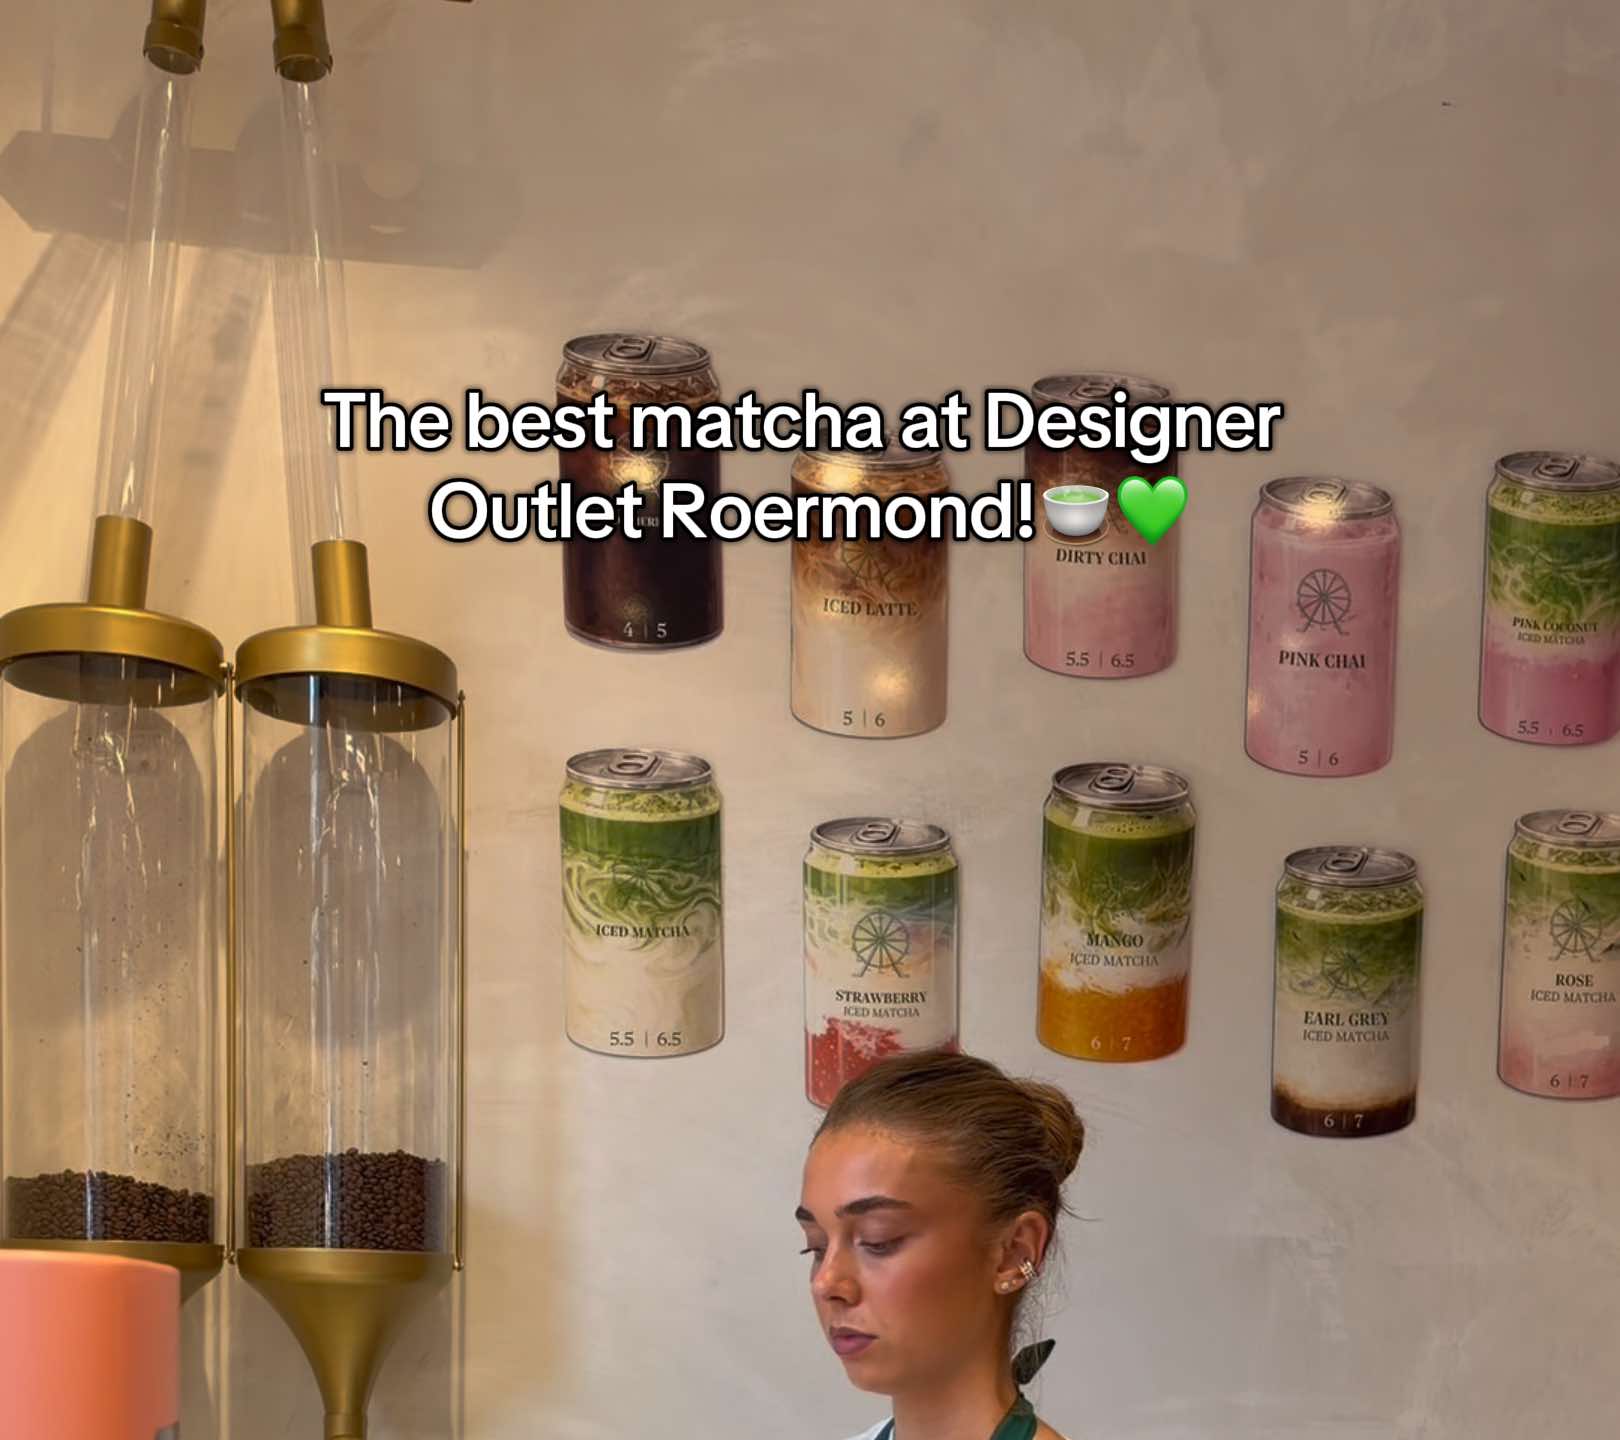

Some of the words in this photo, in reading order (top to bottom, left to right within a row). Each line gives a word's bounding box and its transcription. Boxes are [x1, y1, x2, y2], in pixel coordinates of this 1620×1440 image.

[1055, 547, 1104, 565] DIRTY
[1107, 550, 1147, 566] CHAI
[823, 597, 861, 616] ICED
[865, 599, 918, 618] LATTE
[623, 622, 633, 638] 4
[657, 622, 667, 638] 5
[1512, 616, 1541, 631] PINK
[1543, 619, 1599, 634] COCONUT
[1517, 631, 1541, 644] ICED
[1066, 651, 1089, 667] 5.5
[1111, 652, 1134, 668] 6.5
[1278, 649, 1320, 668] PINK
[1324, 652, 1366, 669] CHAI
[842, 710, 852, 727] 5
[874, 711, 885, 728] 6
[1517, 720, 1539, 735] 5.5
[1562, 722, 1584, 737] 6.5
[1298, 749, 1308, 764] 5
[1329, 751, 1339, 766] 6
[596, 924, 629, 938] ICED
[632, 925, 691, 939] MATCHA
[1087, 932, 1144, 948] MANGO
[1070, 952, 1100, 966] ICED
[1103, 954, 1159, 967] MATCHA
[1555, 973, 1594, 987] ROSE
[835, 989, 927, 1005] STRAWBERRY
[1530, 989, 1560, 1003] ICED
[1563, 991, 1617, 1004] MATCHA
[843, 1006, 869, 1018] ICED
[871, 1006, 920, 1019] MATCHA
[1303, 1010, 1344, 1027] EARL
[1348, 1011, 1390, 1027] GREY
[609, 1032, 634, 1047] 5.5
[656, 1032, 682, 1048] 6.5
[1090, 1036, 1101, 1050] 6
[1122, 1036, 1132, 1051] 7
[1302, 1029, 1331, 1042] ICED
[1334, 1030, 1390, 1043] MATCHA
[1550, 1074, 1560, 1088] 6
[1580, 1075, 1589, 1089] 7
[1324, 1113, 1334, 1128] 6
[1354, 1114, 1364, 1128] 7
